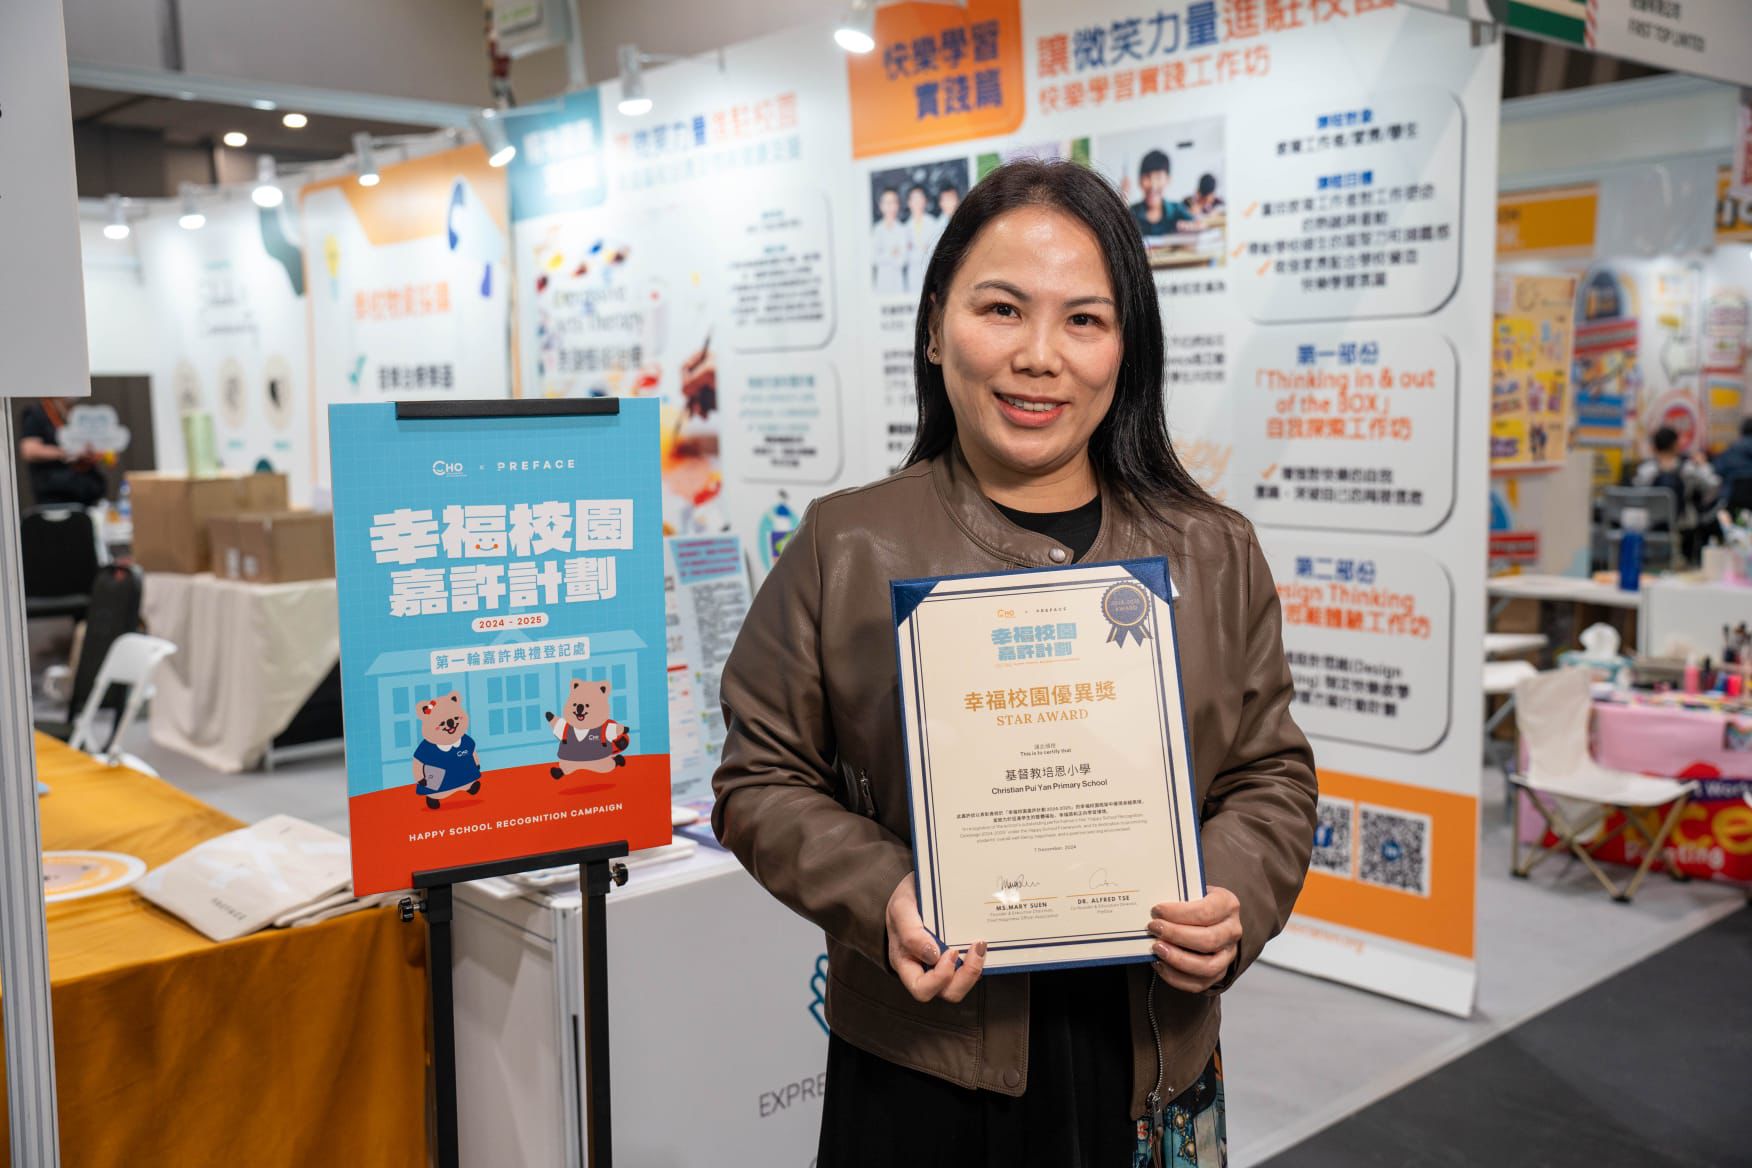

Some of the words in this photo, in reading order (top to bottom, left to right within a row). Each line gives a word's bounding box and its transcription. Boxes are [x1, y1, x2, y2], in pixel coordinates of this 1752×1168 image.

[497, 459, 575, 472] PREFACE
[369, 499, 634, 565] 幸福校園
[389, 556, 617, 618] 嘉許計劃
[479, 618, 505, 629] 2024
[517, 616, 542, 626] 2025
[436, 642, 586, 669] 第一輪嘉許典禮登記處
[964, 681, 1117, 712] 幸福校園優異獎
[996, 713, 1033, 726] STAR
[1037, 708, 1089, 723] AWARD
[1005, 763, 1091, 781] 基督教培恩小學
[991, 785, 1024, 795] Christian
[1025, 784, 1037, 792] Pui
[1038, 783, 1052, 791] Yan
[1053, 780, 1081, 790] Primary
[1082, 778, 1108, 788] School
[409, 829, 445, 842] HAPPY
[449, 823, 493, 836] SCHOOL
[496, 811, 567, 829] RECOGNITION
[570, 803, 623, 817] CAMPAIGN
[1091, 896, 1116, 904] ALFRED
